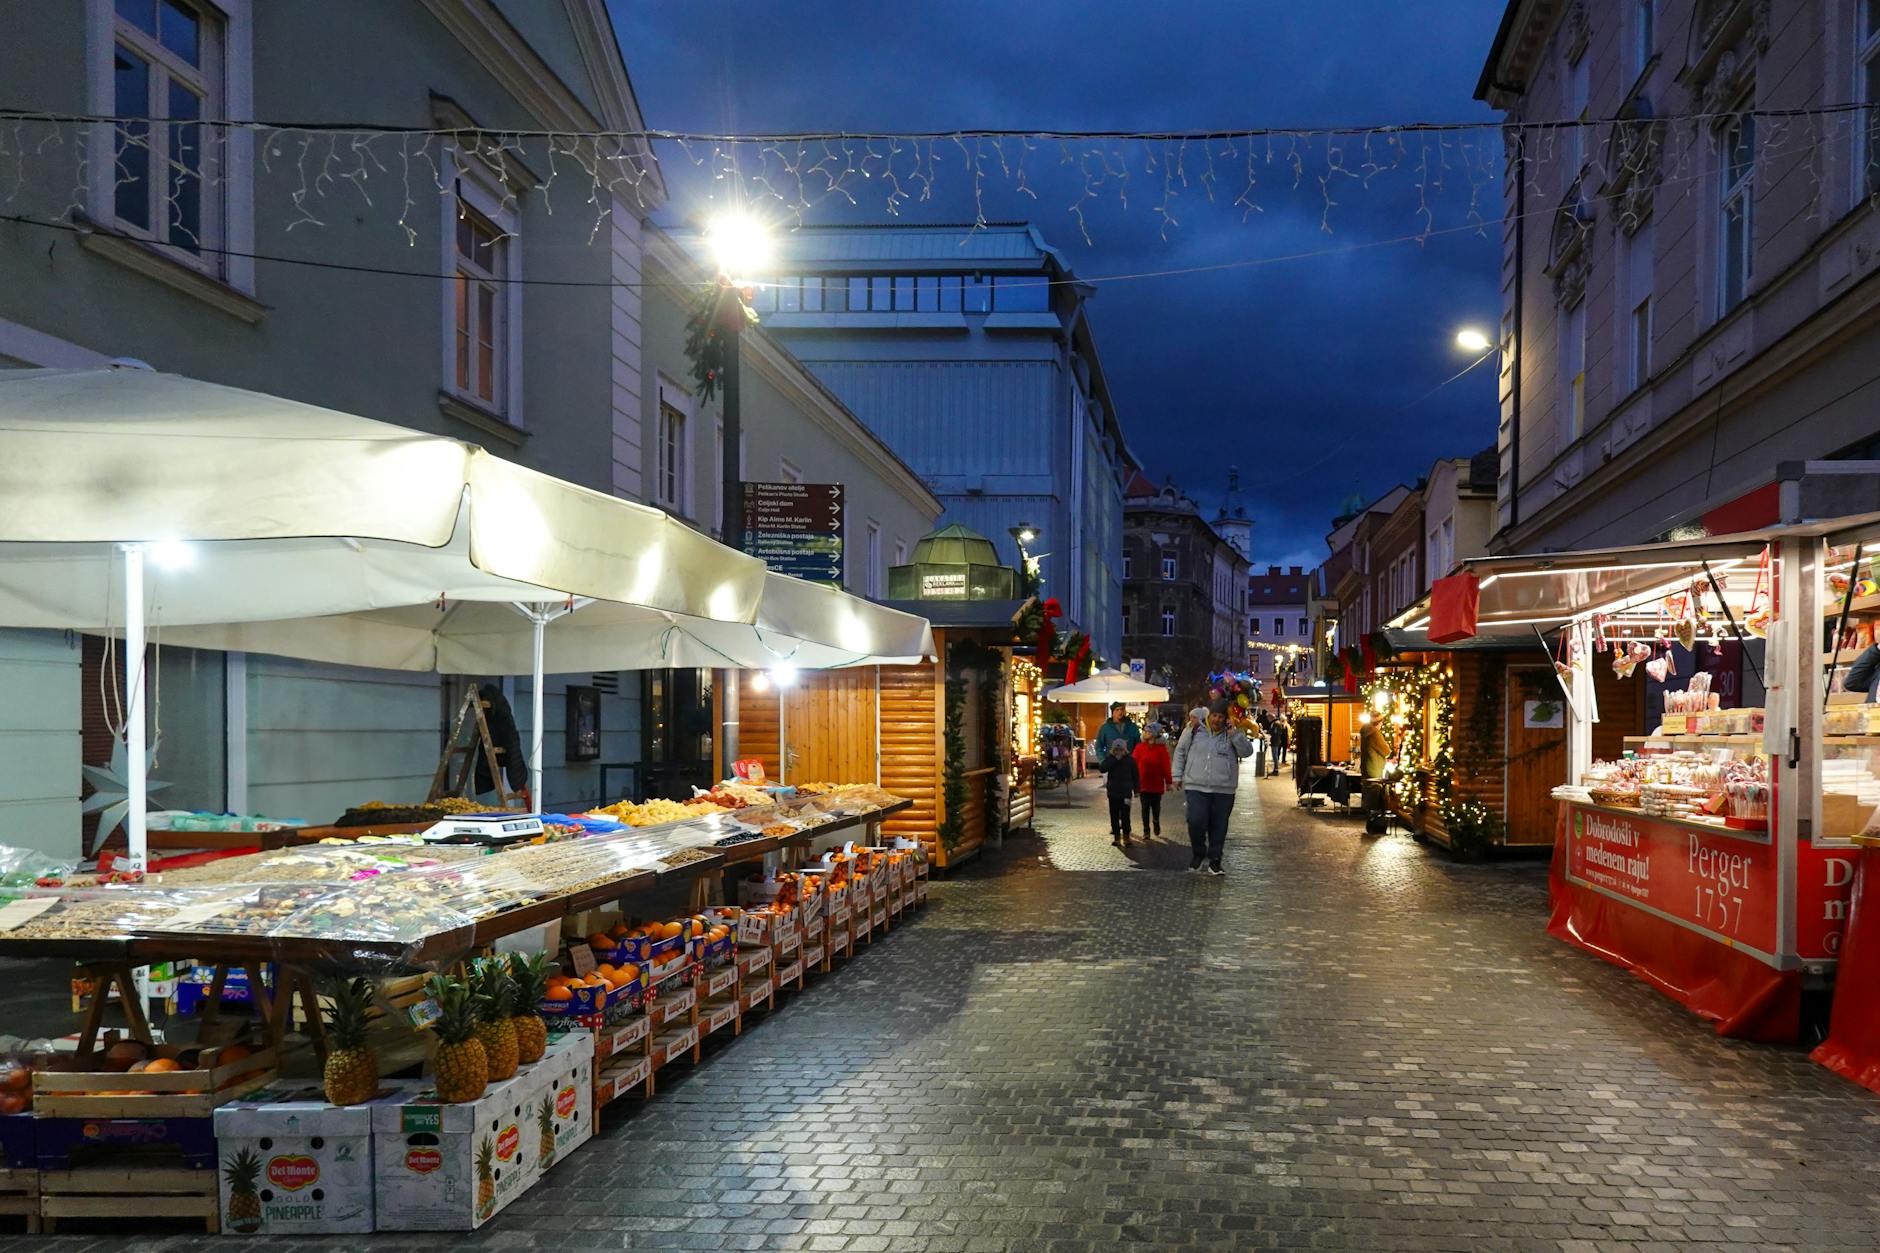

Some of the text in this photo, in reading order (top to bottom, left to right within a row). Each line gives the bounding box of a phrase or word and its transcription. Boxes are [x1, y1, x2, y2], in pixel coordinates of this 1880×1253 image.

[1586, 814, 1640, 848] Dobrodošli v
[1586, 842, 1650, 884] medenem raju!
[1688, 833, 1752, 896] Perger
[1696, 885, 1743, 934] 1757
[272, 1166, 316, 1176] Del Monte
[266, 1206, 322, 1220] PINEAPPLE
